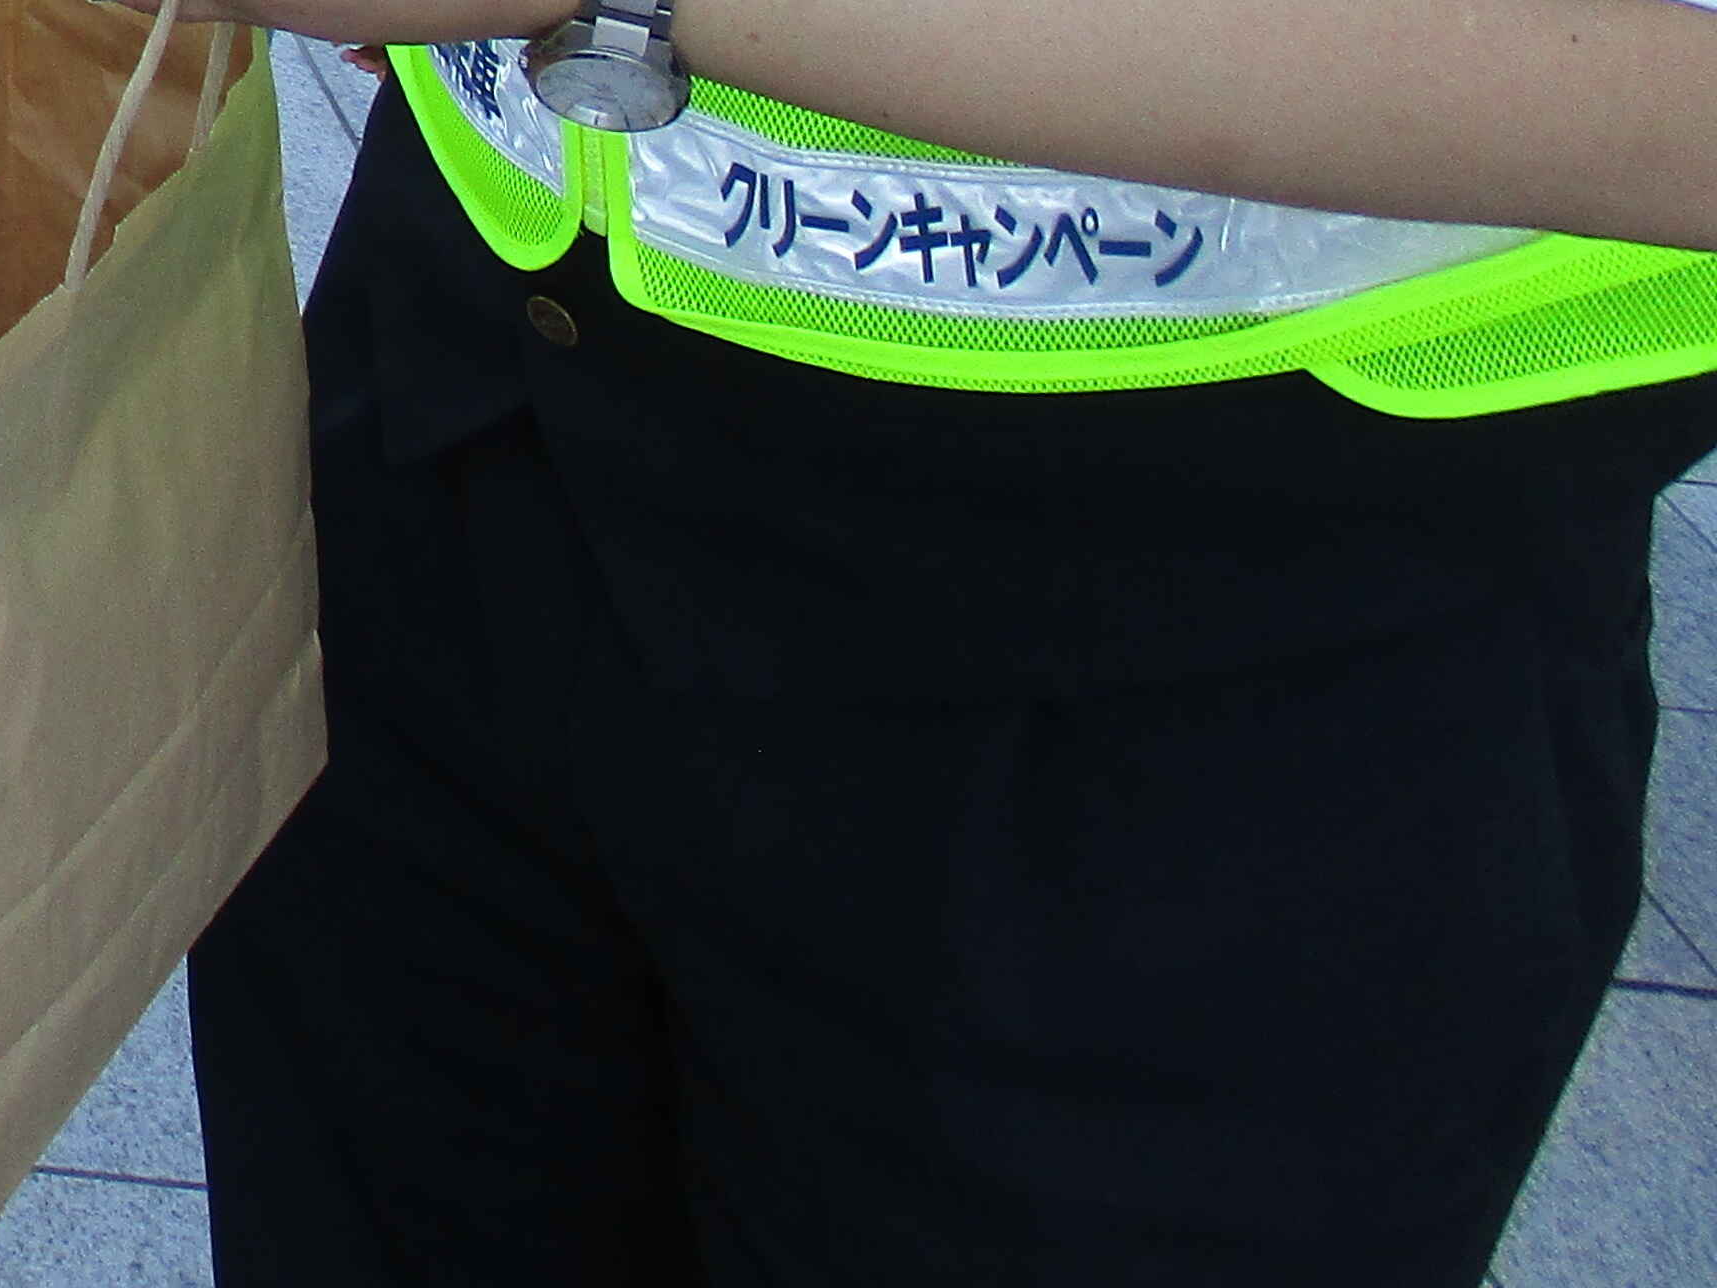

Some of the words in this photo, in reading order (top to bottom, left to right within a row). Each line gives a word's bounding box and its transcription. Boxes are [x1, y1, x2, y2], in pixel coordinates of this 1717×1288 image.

[719, 160, 1205, 291] クリーンキャンペーン
